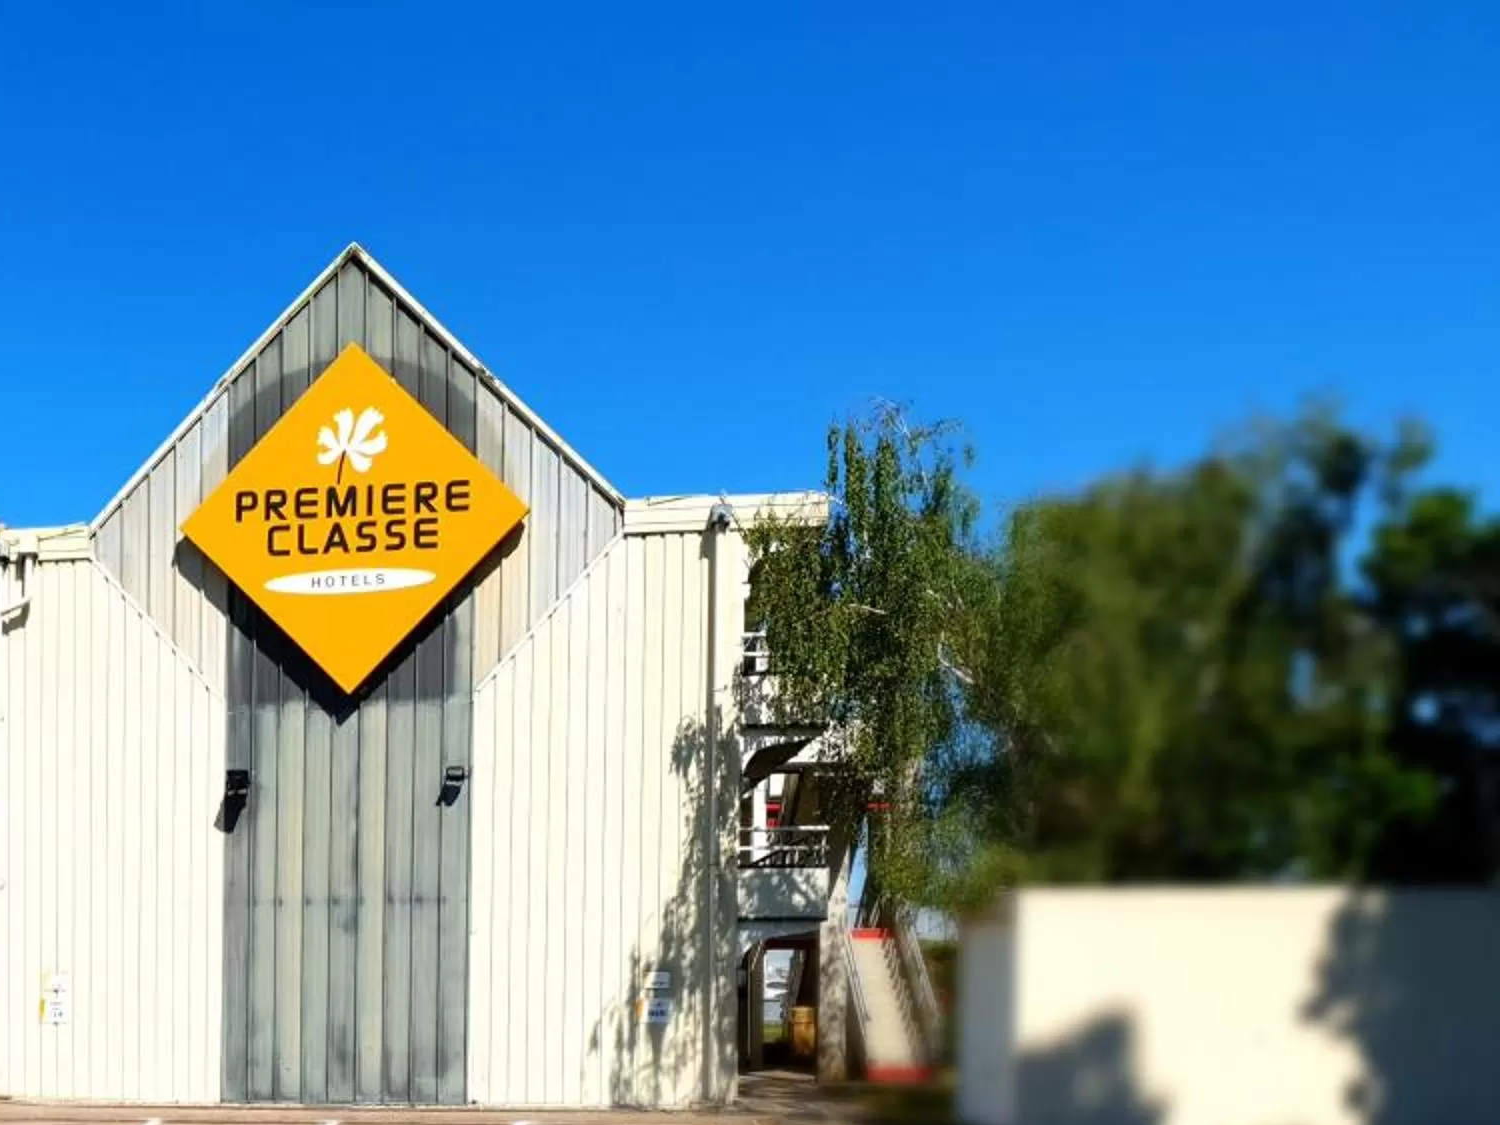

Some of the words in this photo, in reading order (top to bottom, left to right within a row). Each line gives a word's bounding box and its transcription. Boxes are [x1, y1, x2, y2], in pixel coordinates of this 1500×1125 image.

[235, 480, 471, 522] PREMIERE
[267, 518, 438, 556] CLASSE
[311, 573, 385, 588] HOTELS
